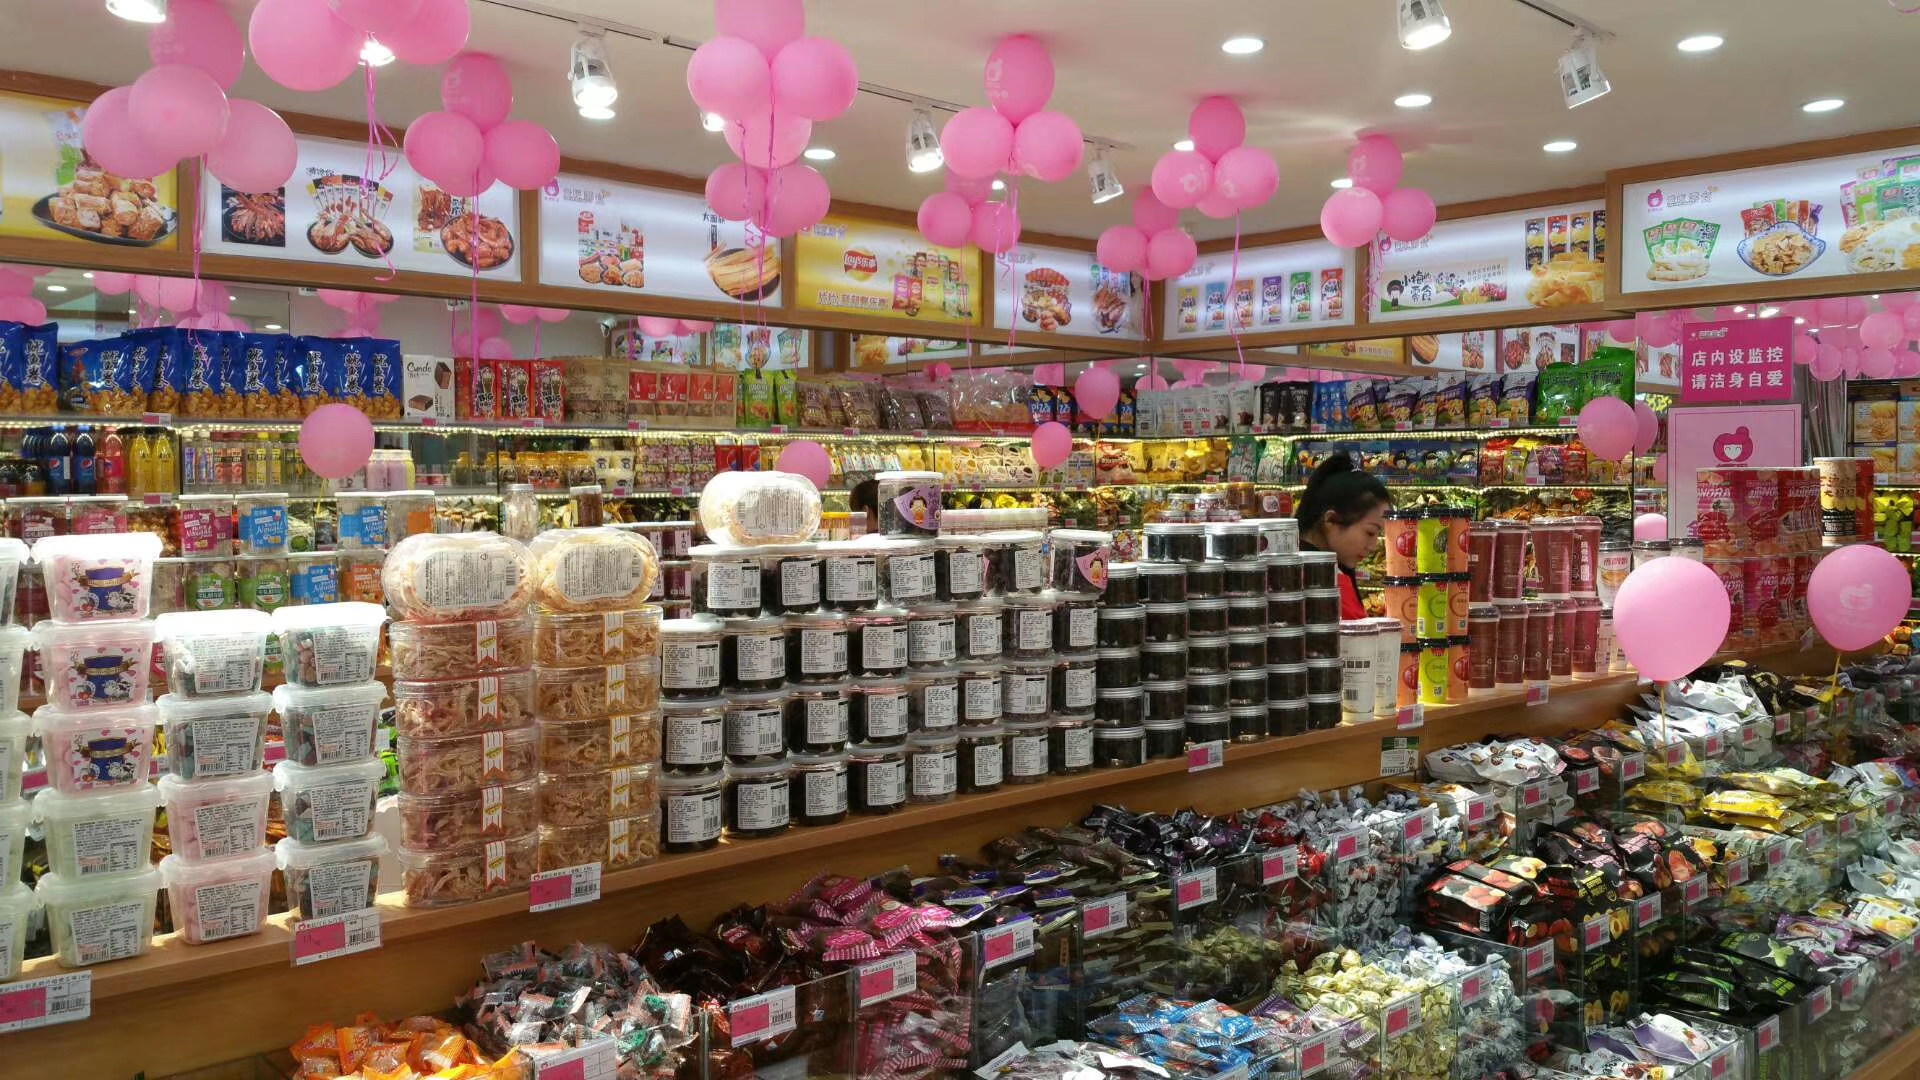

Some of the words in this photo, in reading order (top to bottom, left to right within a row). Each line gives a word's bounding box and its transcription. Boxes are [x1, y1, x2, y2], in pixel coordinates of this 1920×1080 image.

[1691, 346, 1784, 367] 店内设监控
[1691, 370, 1784, 390] 请洁身自爱
